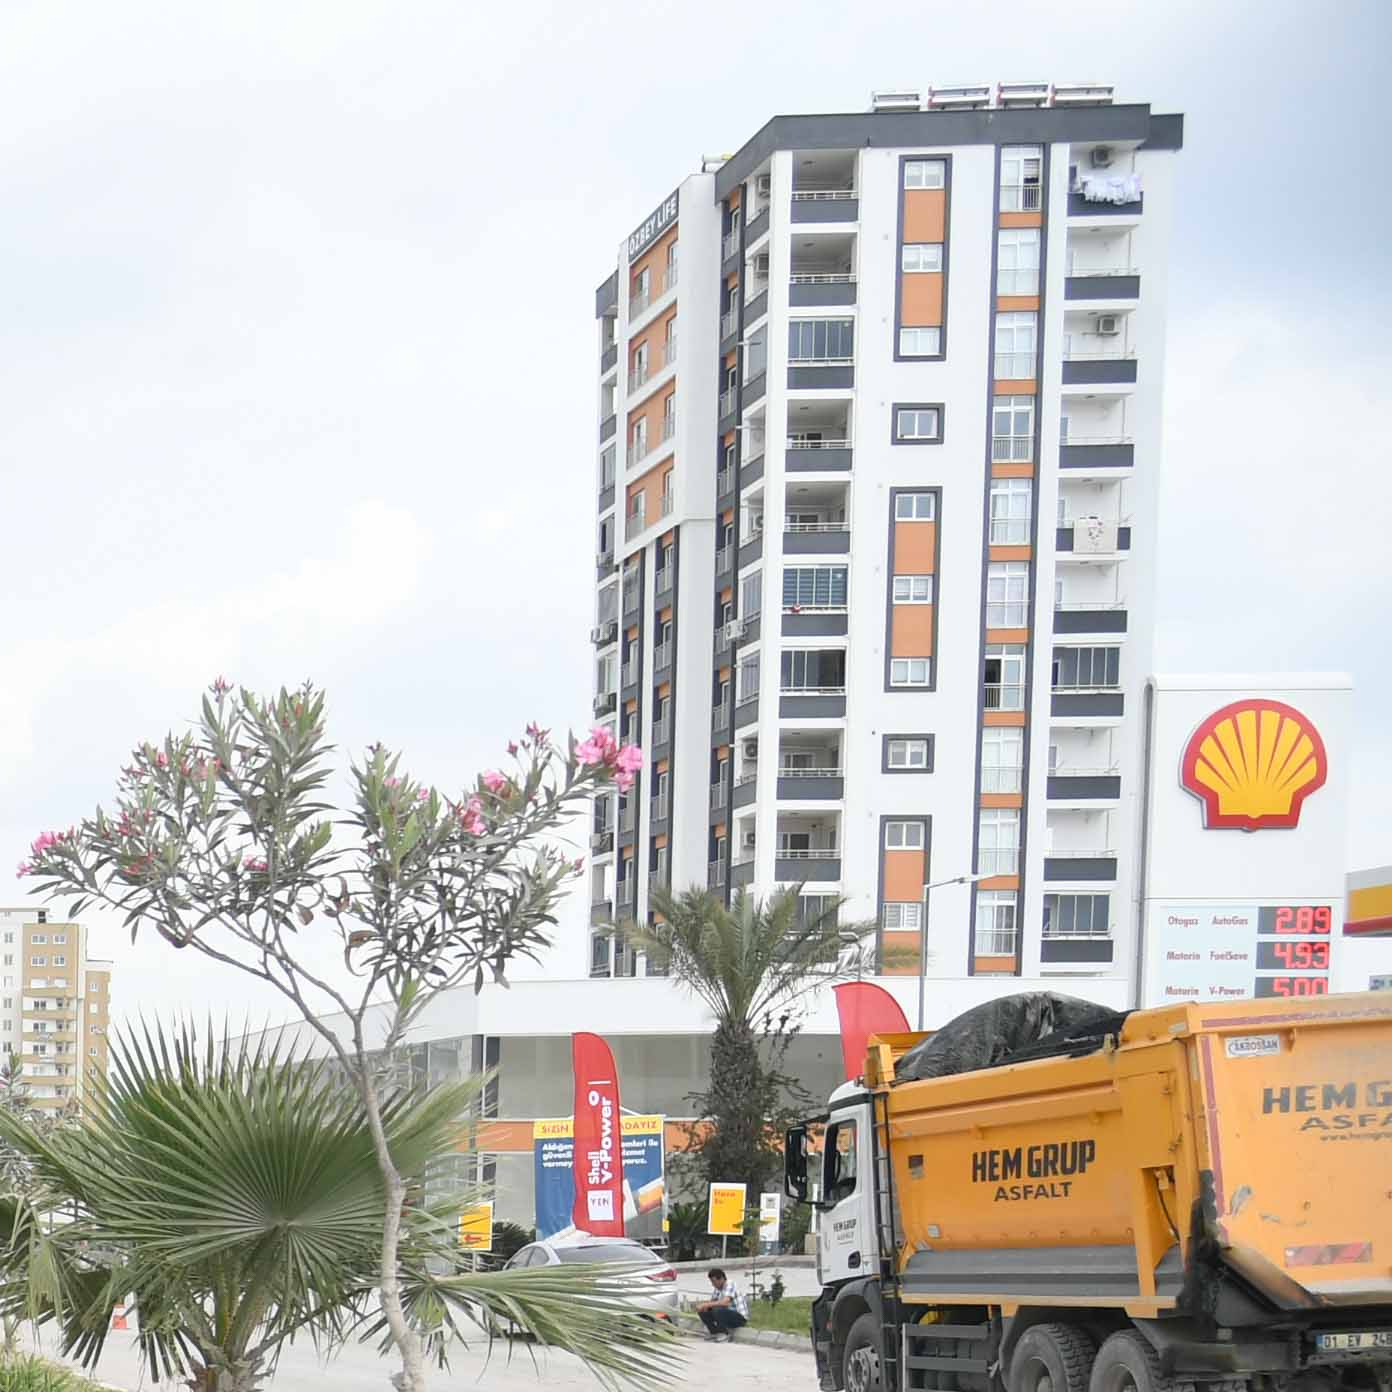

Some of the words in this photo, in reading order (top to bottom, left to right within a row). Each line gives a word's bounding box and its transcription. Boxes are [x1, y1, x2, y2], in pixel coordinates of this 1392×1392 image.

[1262, 1082, 1356, 1114] HEM
[588, 1152, 600, 1184] Shell
[972, 1148, 1022, 1183] HEM
[1027, 1139, 1096, 1178] GRUP
[994, 1181, 1073, 1202] ASFALT
